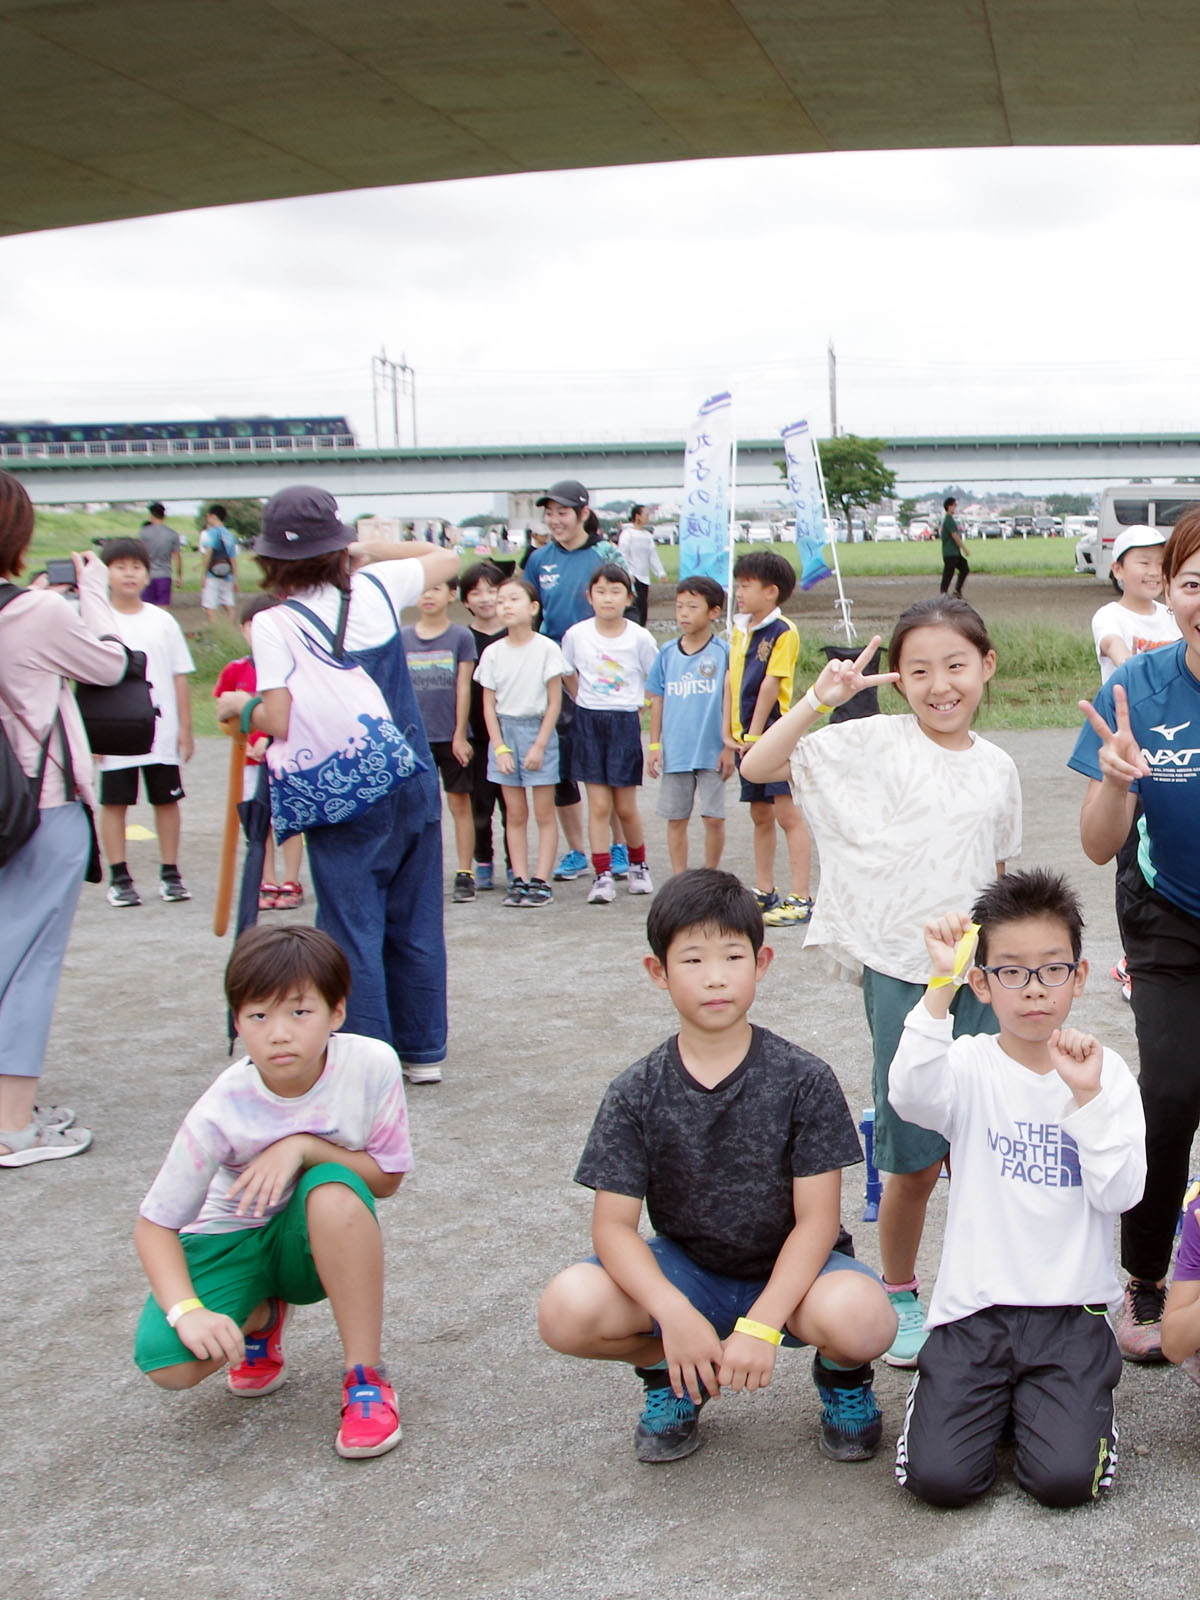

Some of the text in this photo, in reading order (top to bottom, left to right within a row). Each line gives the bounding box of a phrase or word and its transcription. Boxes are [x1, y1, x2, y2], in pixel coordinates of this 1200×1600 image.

[667, 672, 716, 699] FUJITSU
[987, 1127, 1058, 1166] NORTH
[1014, 1121, 1059, 1145] THE
[1000, 1158, 1058, 1187] FACE
